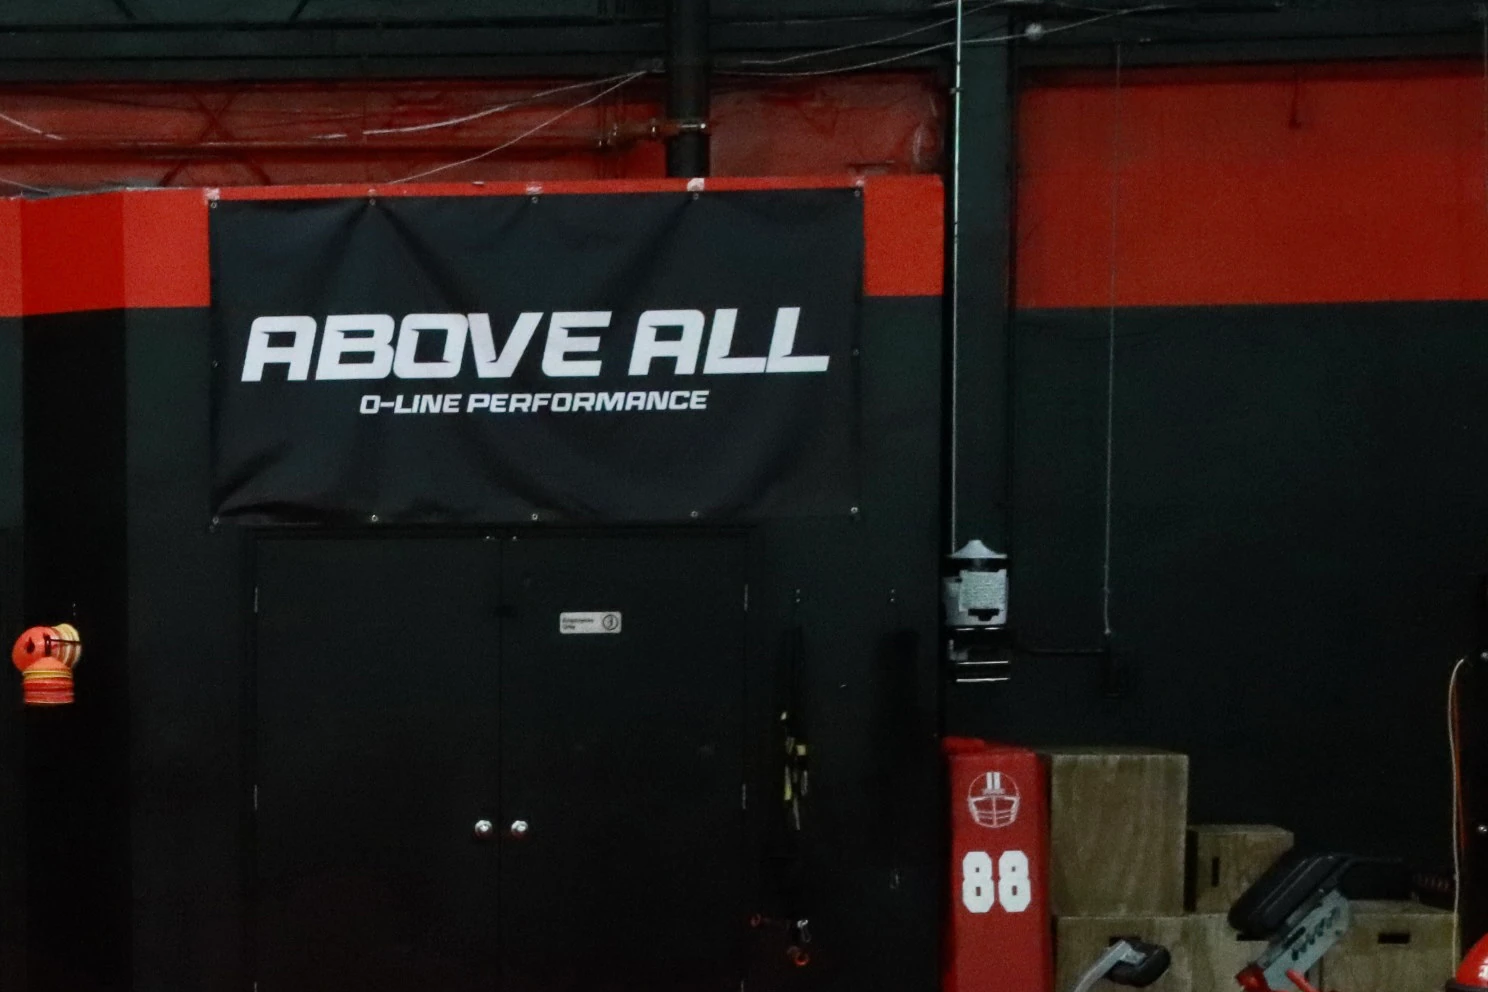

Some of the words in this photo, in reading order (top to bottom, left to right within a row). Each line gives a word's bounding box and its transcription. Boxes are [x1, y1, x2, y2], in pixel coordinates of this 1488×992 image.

[241, 311, 613, 382] ABOVE
[628, 306, 831, 376] ALL
[359, 393, 460, 415] O-LINE
[466, 390, 710, 414] PERFORMANCE
[962, 850, 1031, 914] 88
